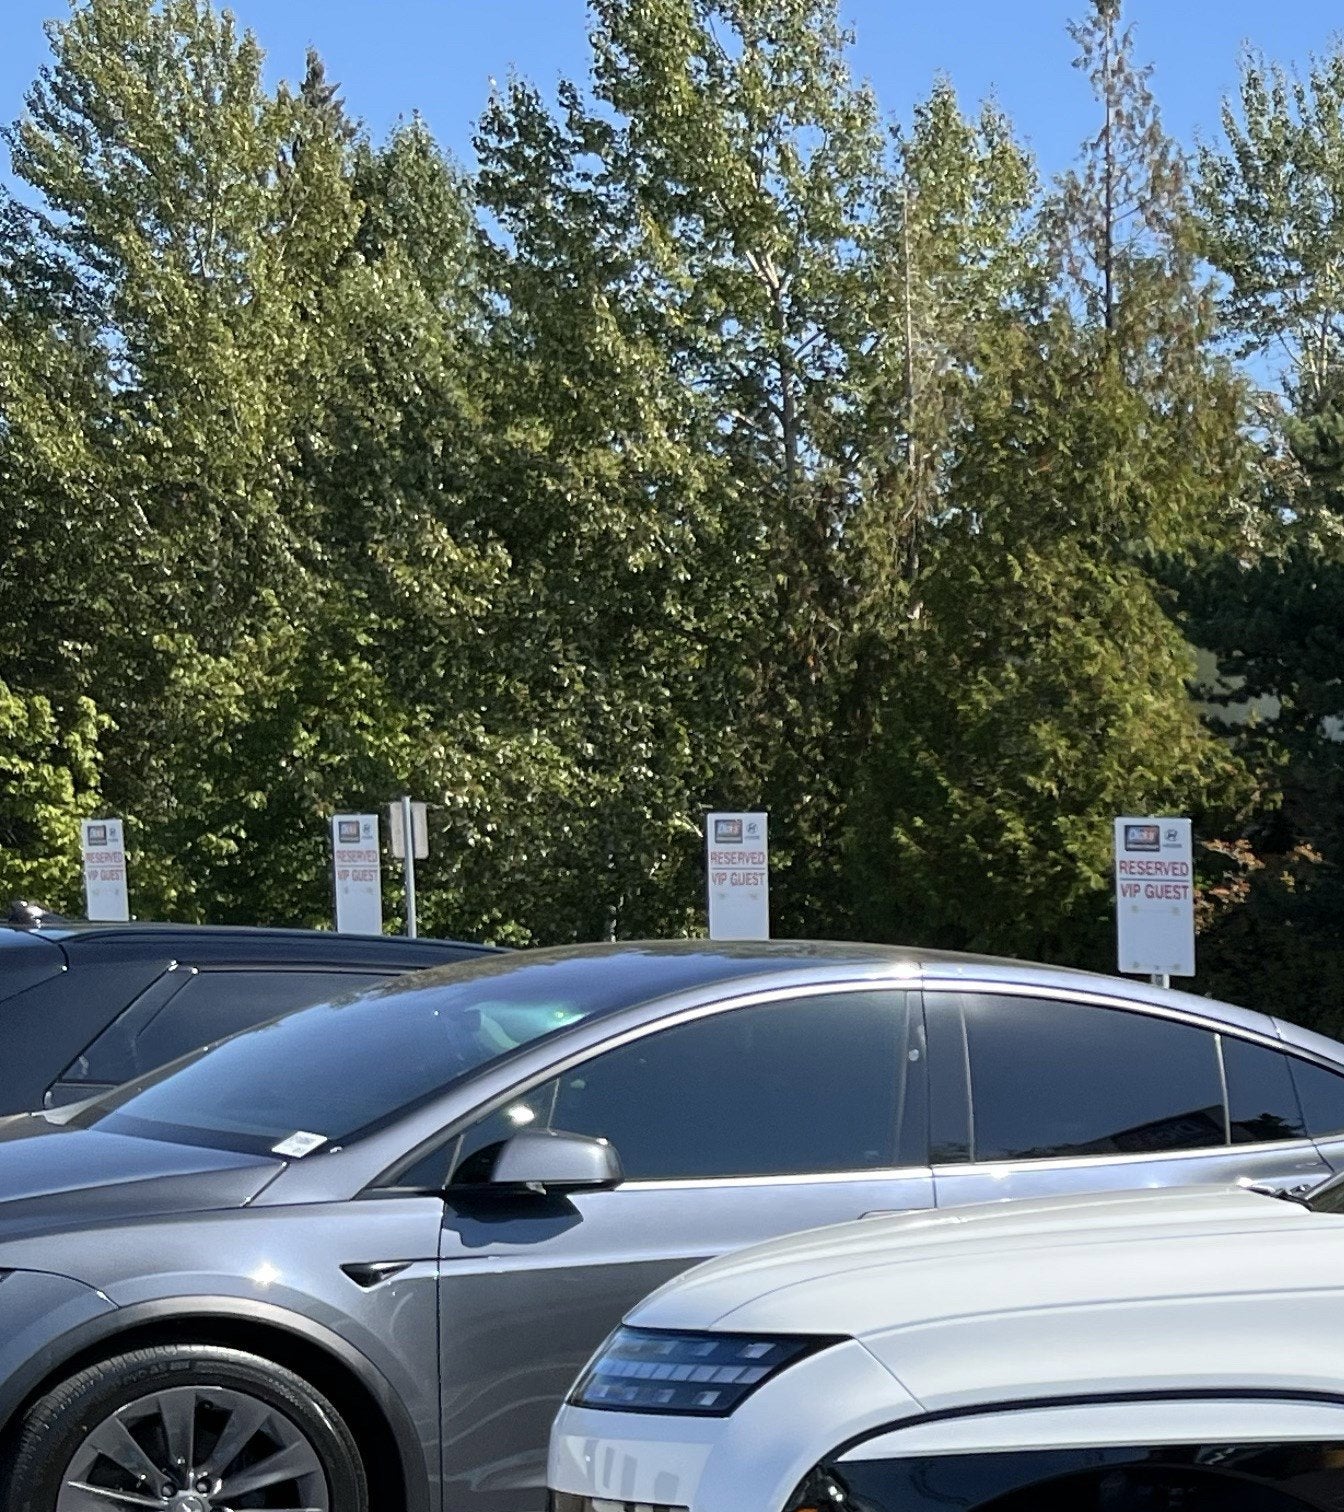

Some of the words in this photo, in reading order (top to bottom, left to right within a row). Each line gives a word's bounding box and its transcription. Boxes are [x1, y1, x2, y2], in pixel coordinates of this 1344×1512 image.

[336, 849, 378, 863] RESERVED
[710, 851, 766, 866] RESERVED
[337, 869, 350, 881] VIP
[352, 869, 378, 882] GUEST
[1119, 860, 1190, 877] RESERVED
[711, 872, 727, 886] VIP
[730, 872, 766, 887] GUEST
[1120, 883, 1141, 899] VIP
[1145, 884, 1189, 900] GUEST
